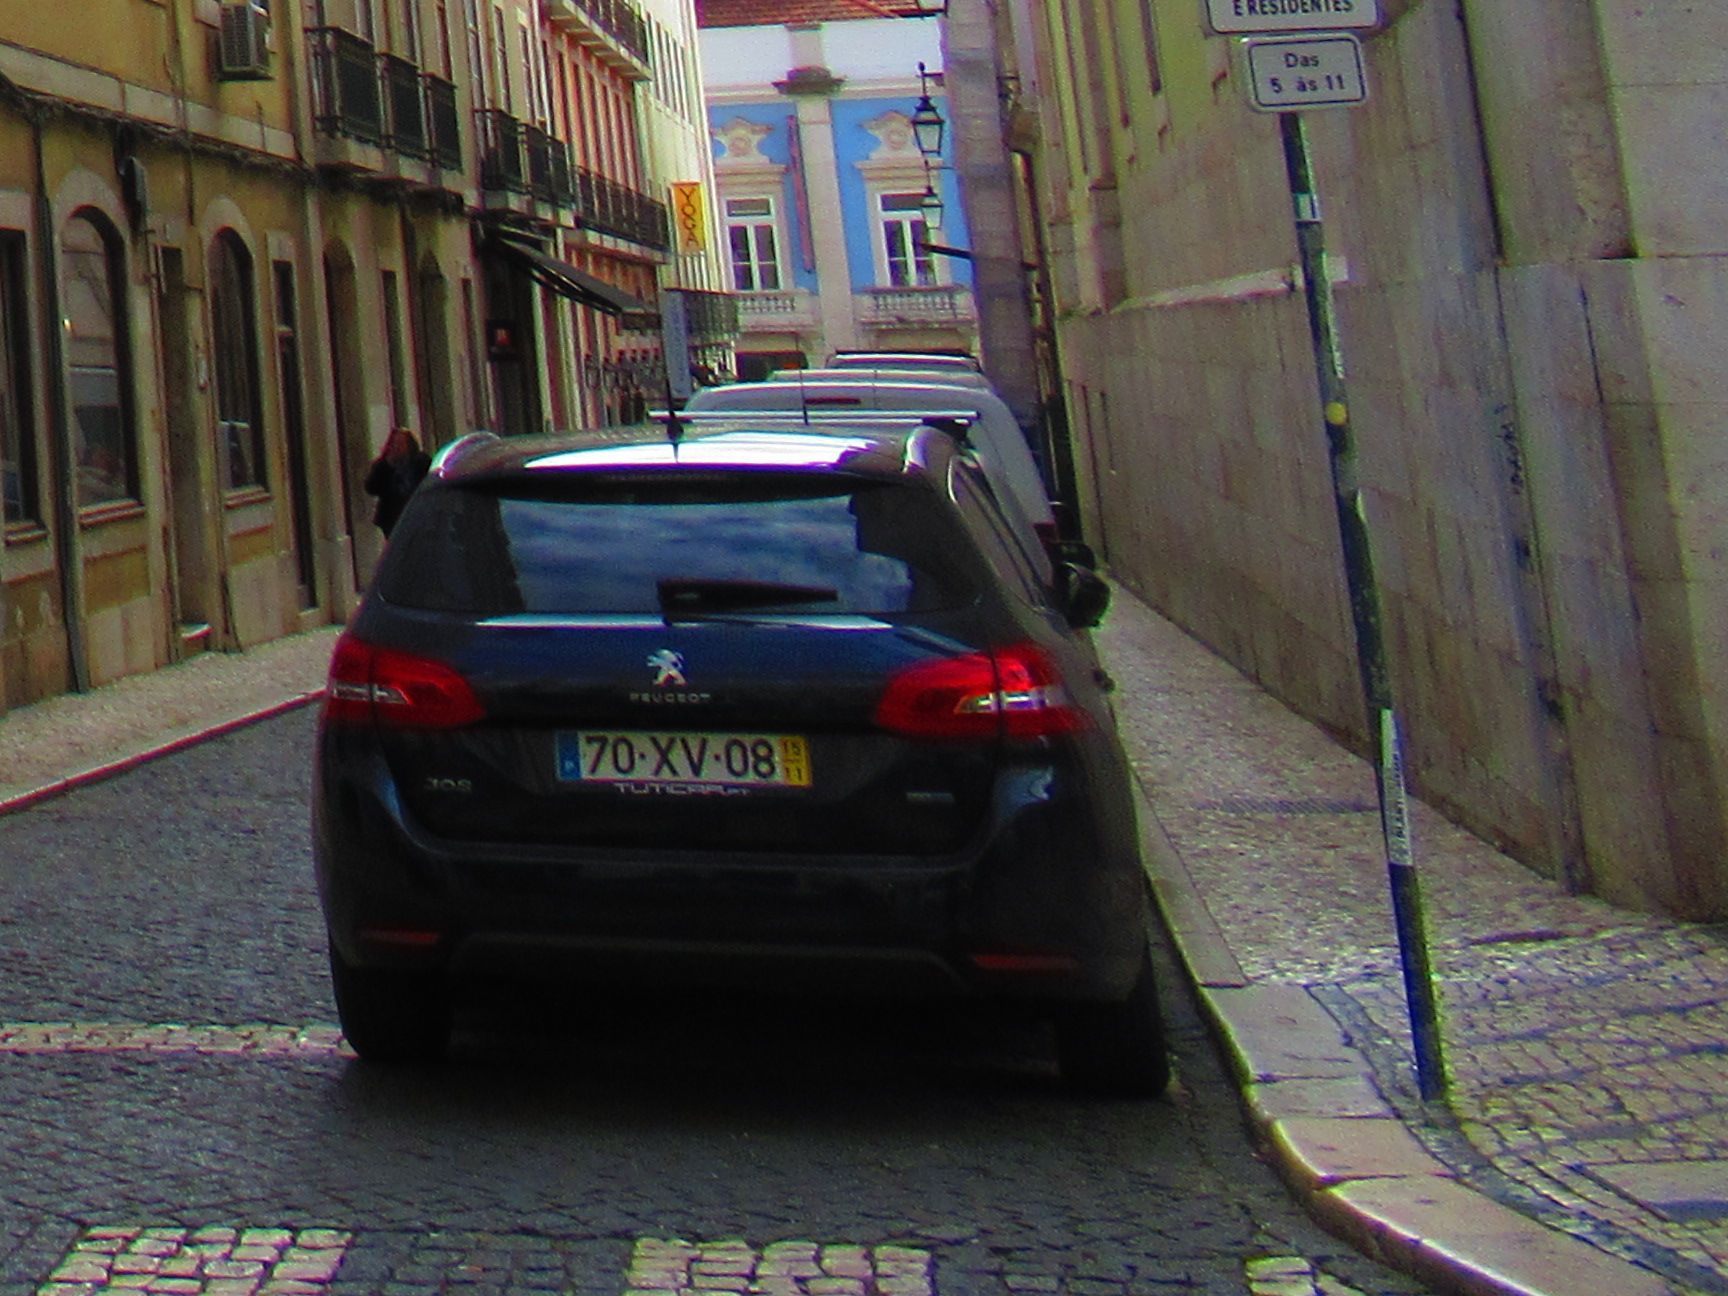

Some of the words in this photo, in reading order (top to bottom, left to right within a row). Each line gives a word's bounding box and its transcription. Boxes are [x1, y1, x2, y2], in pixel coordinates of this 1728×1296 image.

[1284, 52, 1320, 68] Das
[1270, 77, 1282, 94] 5
[1325, 73, 1345, 91] 11
[679, 188, 700, 247] YOGA
[629, 692, 712, 704] PEUGEOT
